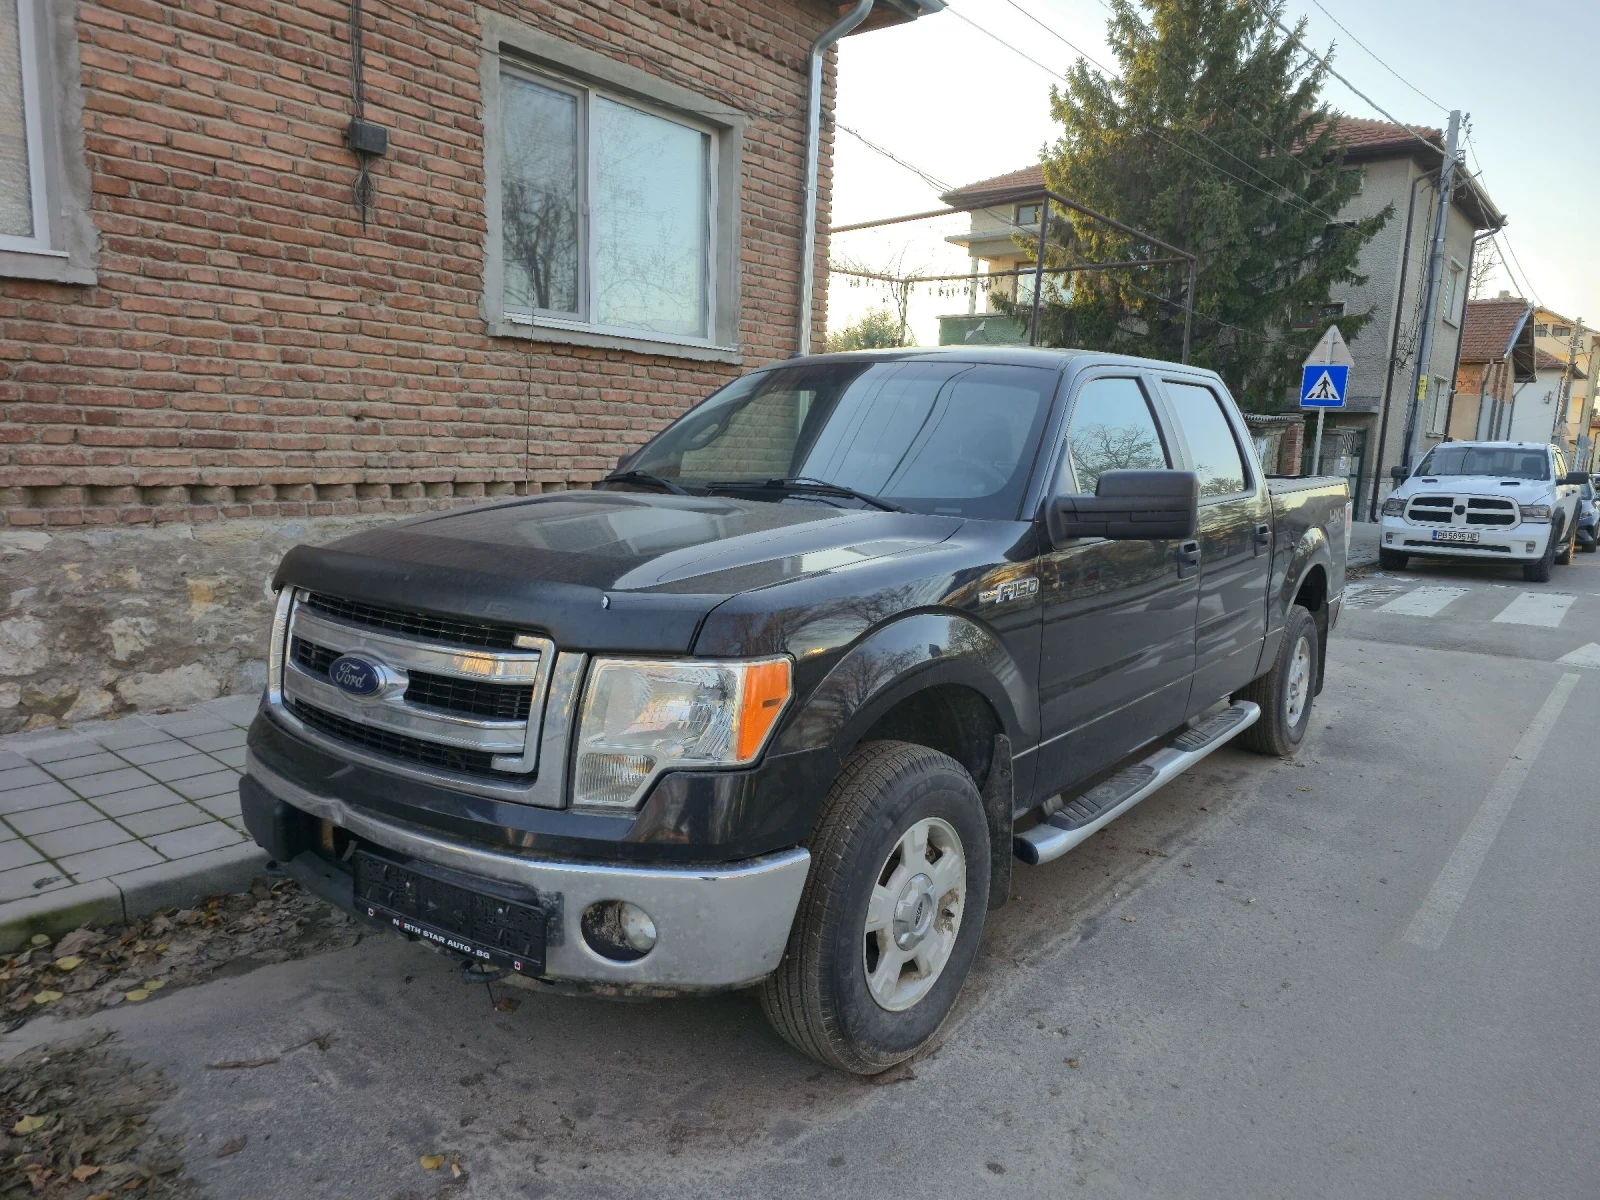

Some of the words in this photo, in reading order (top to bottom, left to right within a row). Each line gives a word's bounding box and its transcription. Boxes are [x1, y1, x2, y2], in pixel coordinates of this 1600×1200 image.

[335, 662, 367, 688] Ford
[392, 918, 421, 934] NRTH
[422, 930, 446, 943] STAR
